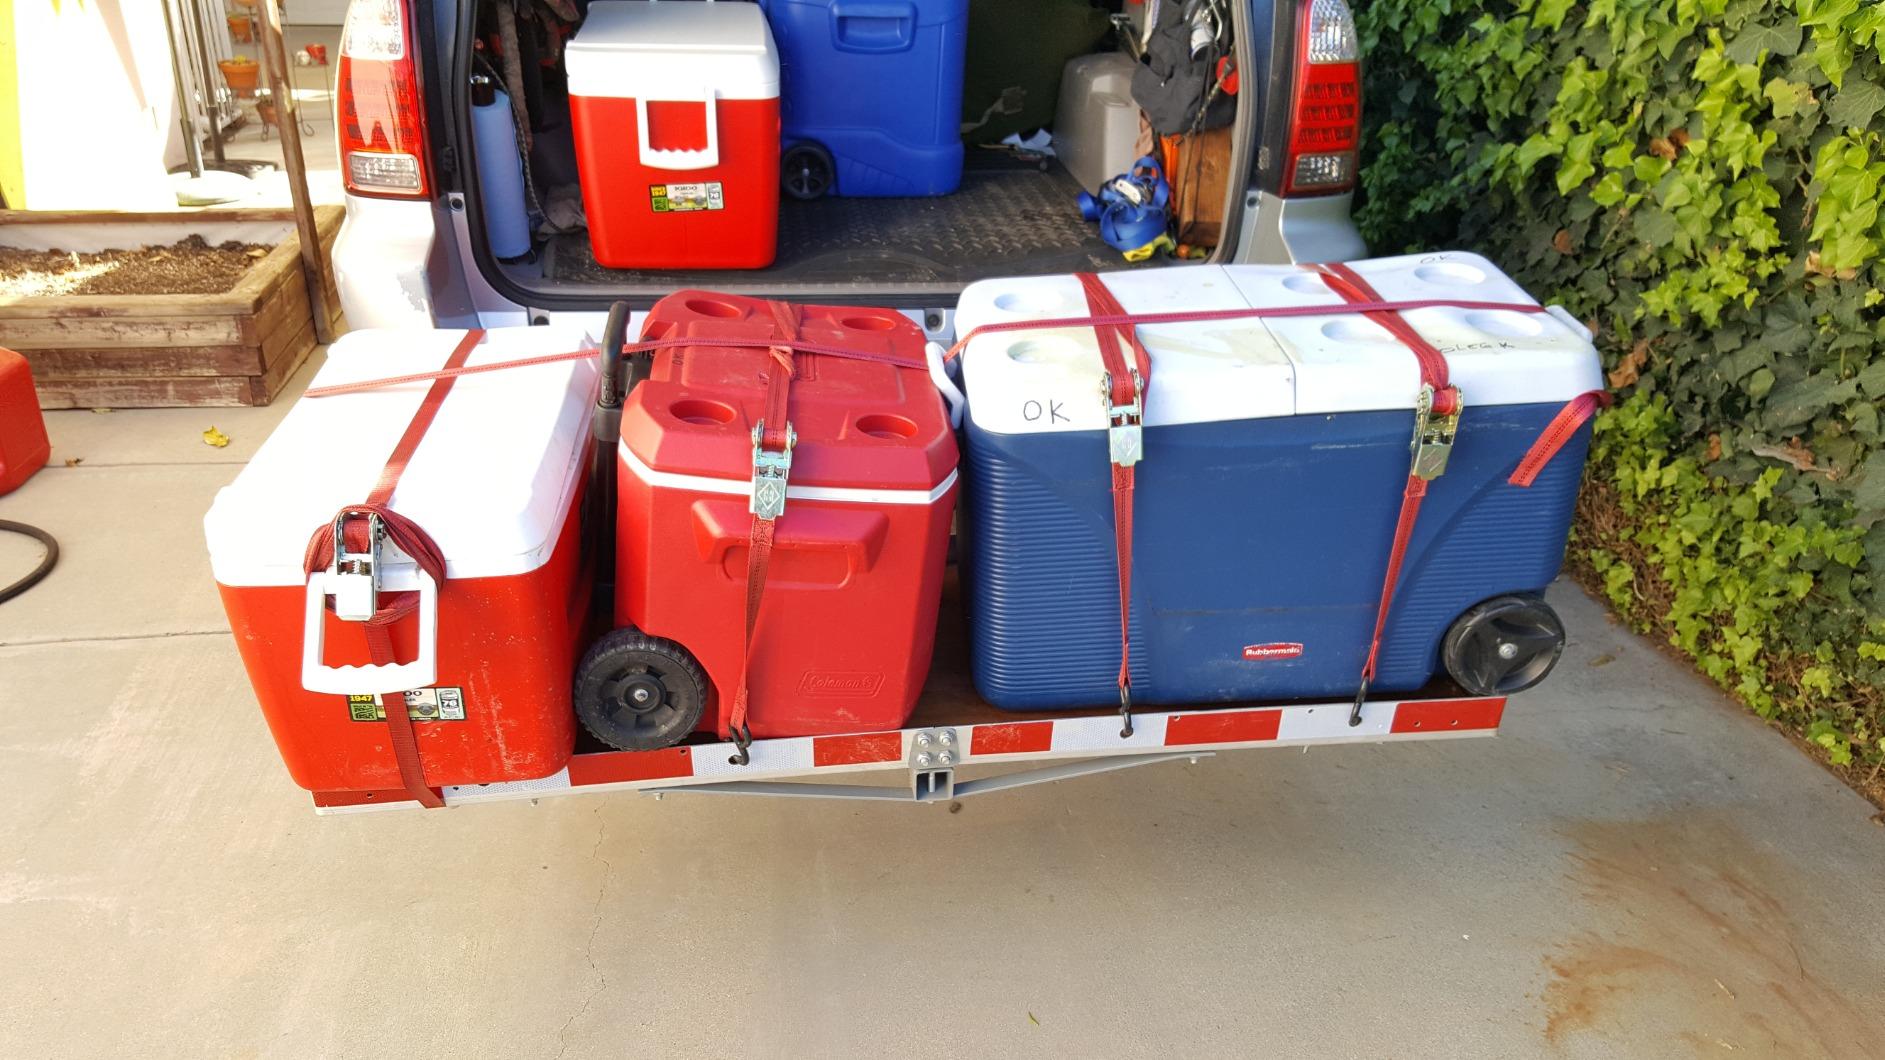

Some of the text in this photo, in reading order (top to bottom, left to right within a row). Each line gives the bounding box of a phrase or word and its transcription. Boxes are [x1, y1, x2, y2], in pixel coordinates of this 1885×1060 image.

[1023, 399, 1070, 424] OK
[1245, 647, 1300, 656] Rubbermaid
[808, 675, 860, 689] Coleman
